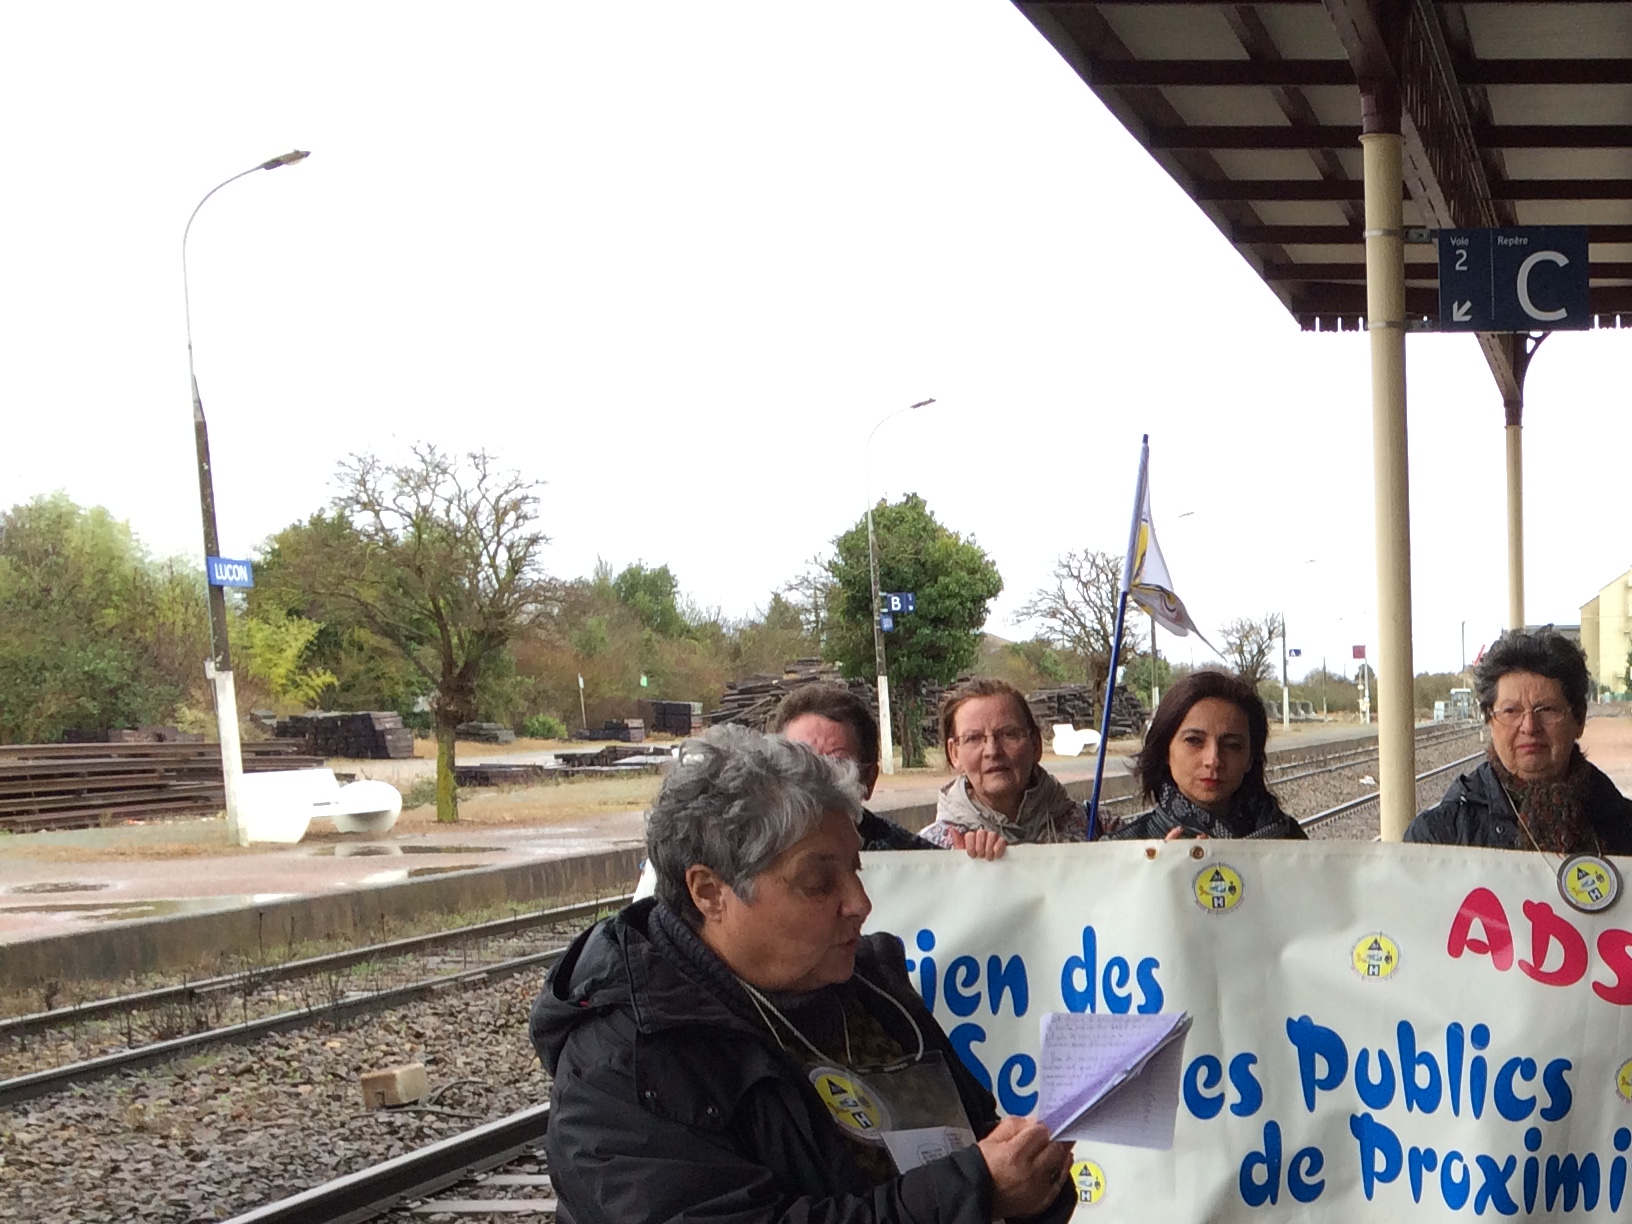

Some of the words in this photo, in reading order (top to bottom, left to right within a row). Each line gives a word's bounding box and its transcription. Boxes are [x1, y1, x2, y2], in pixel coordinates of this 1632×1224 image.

[1450, 236, 1469, 247] Voie
[1455, 249, 1468, 271] 2
[1497, 236, 1528, 247] Repère
[1516, 250, 1570, 321] C
[891, 596, 902, 610] B
[1060, 925, 1165, 1015] des
[1286, 1015, 1573, 1122] Publics
[1239, 1120, 1326, 1207] de
